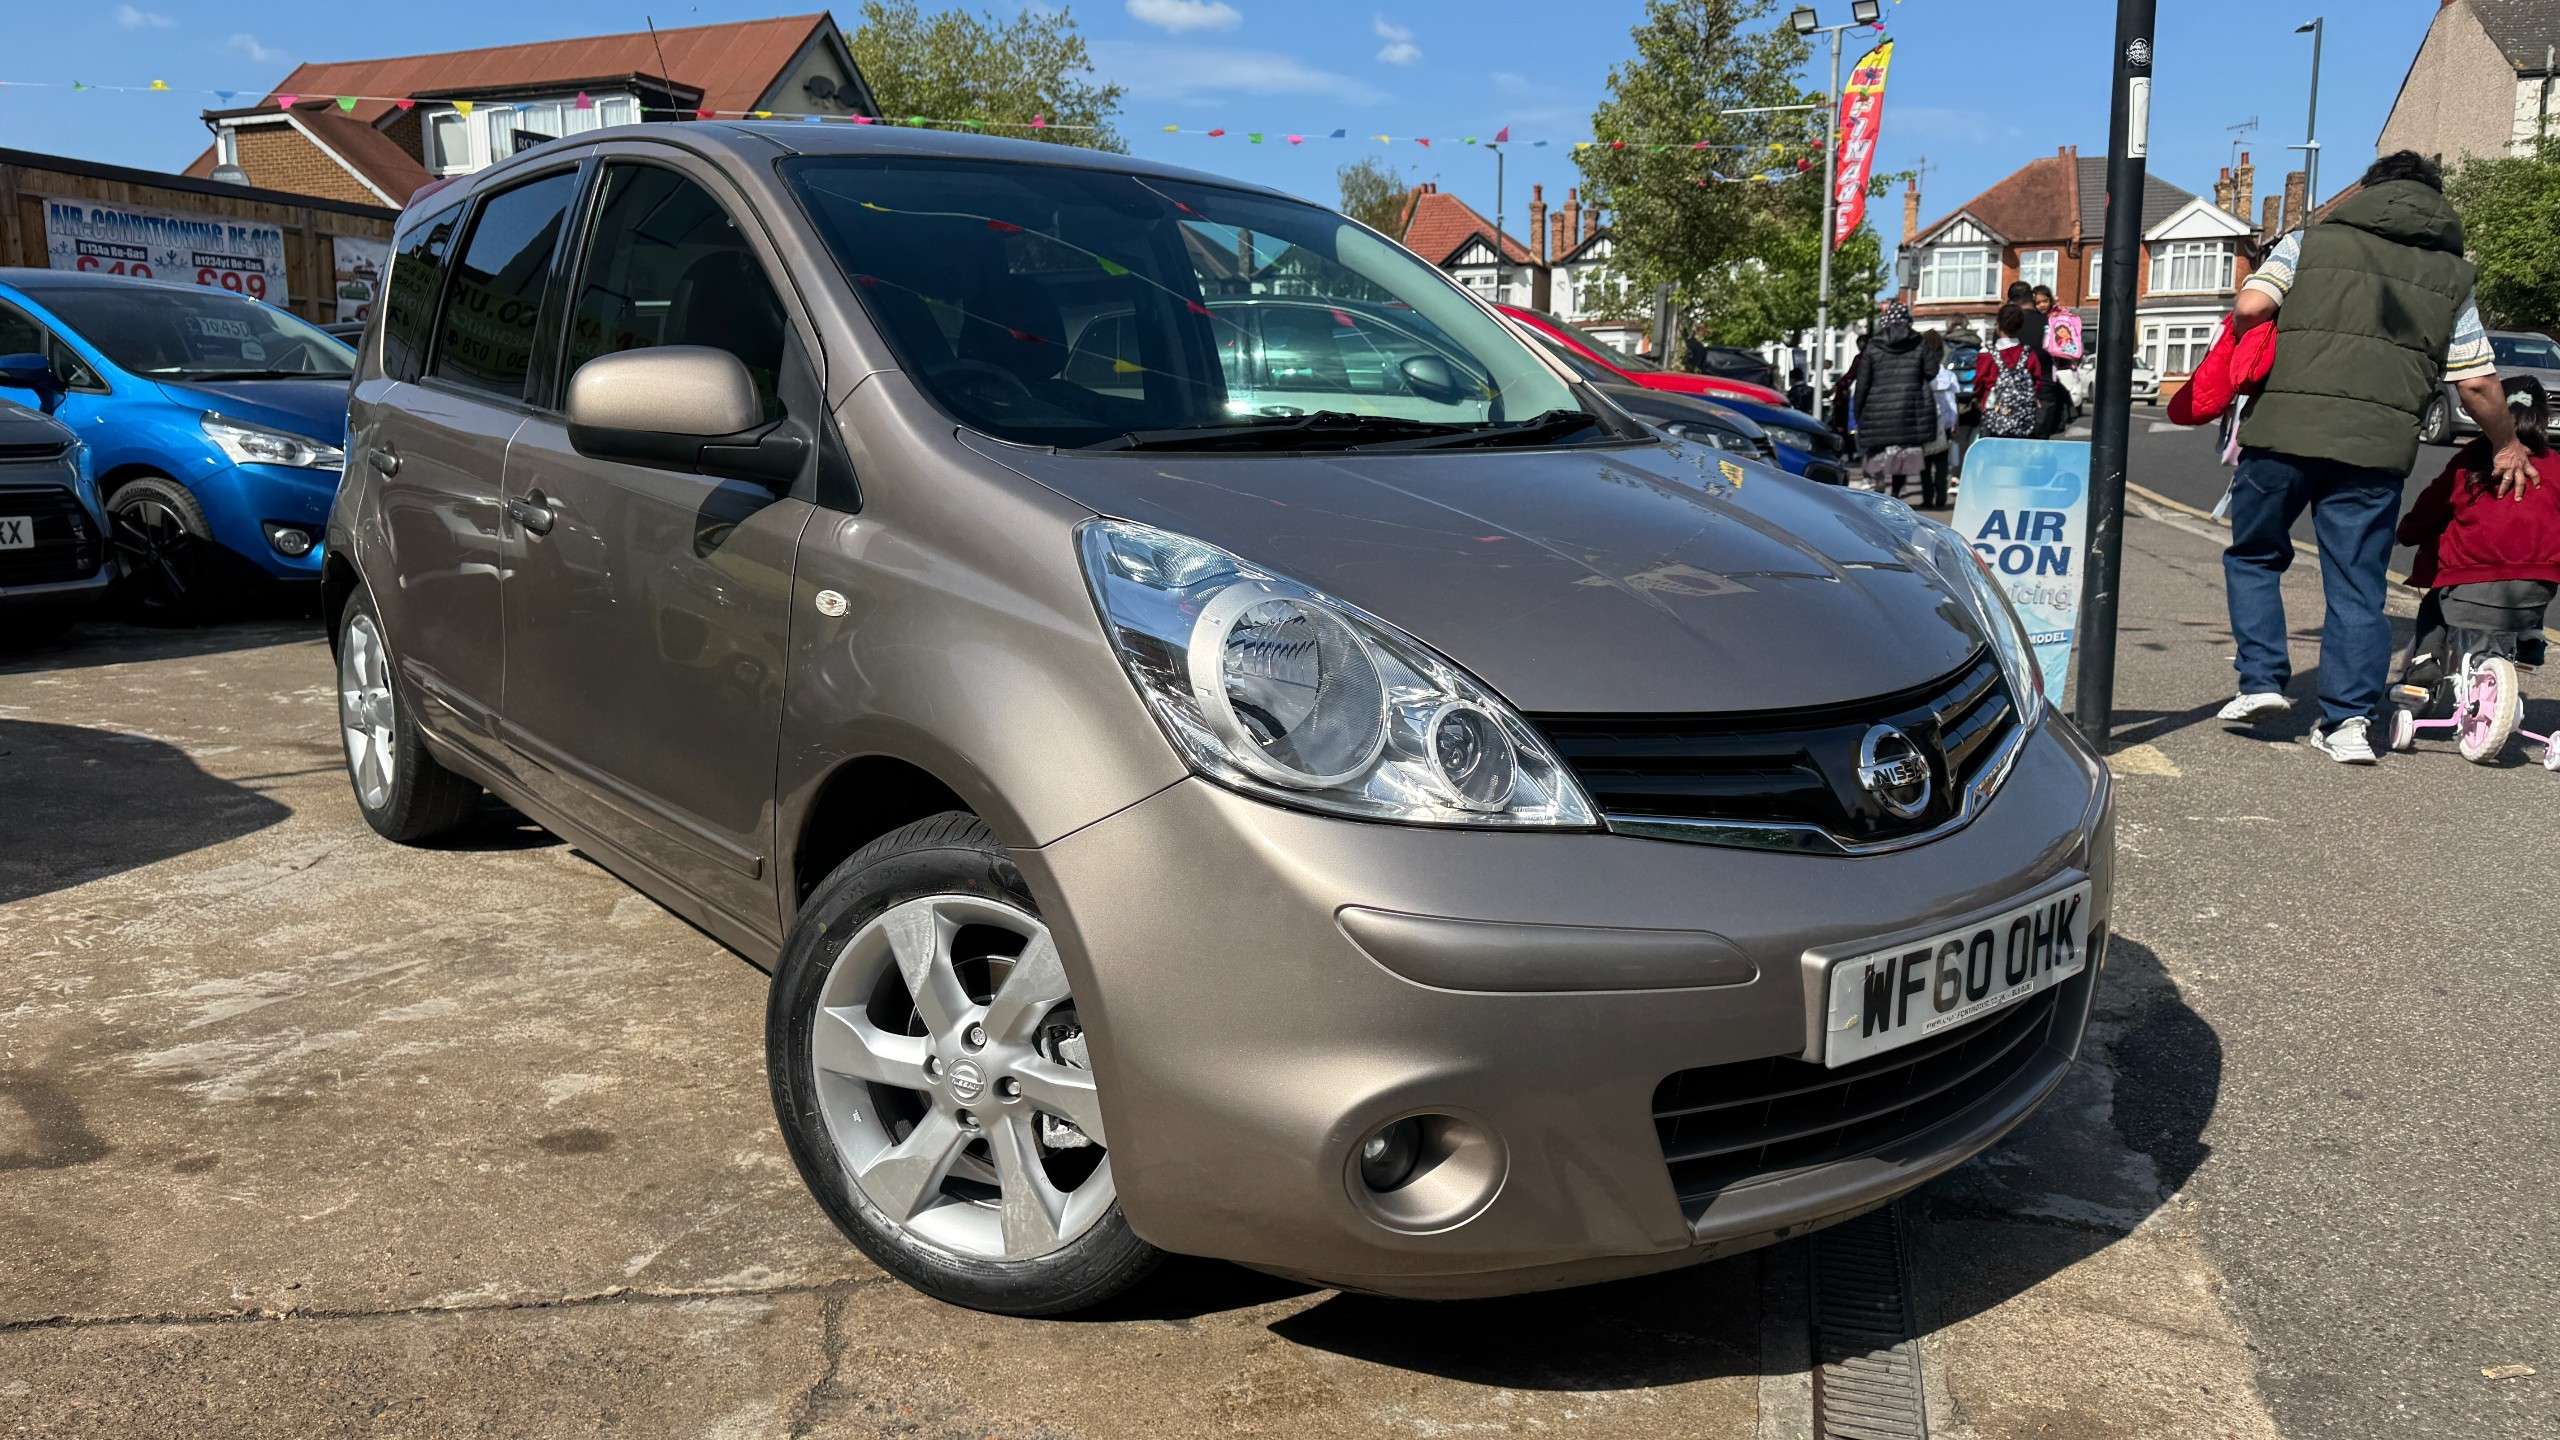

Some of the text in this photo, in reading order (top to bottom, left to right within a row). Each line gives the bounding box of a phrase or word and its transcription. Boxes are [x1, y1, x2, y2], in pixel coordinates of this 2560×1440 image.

[50, 202, 281, 258] AIR-CONDITIONING RE-GAS
[1976, 509, 2067, 542] AIR
[2003, 581, 2072, 611] icing
[1862, 929, 1995, 1039] WF60
[2005, 893, 2081, 986] OHK
